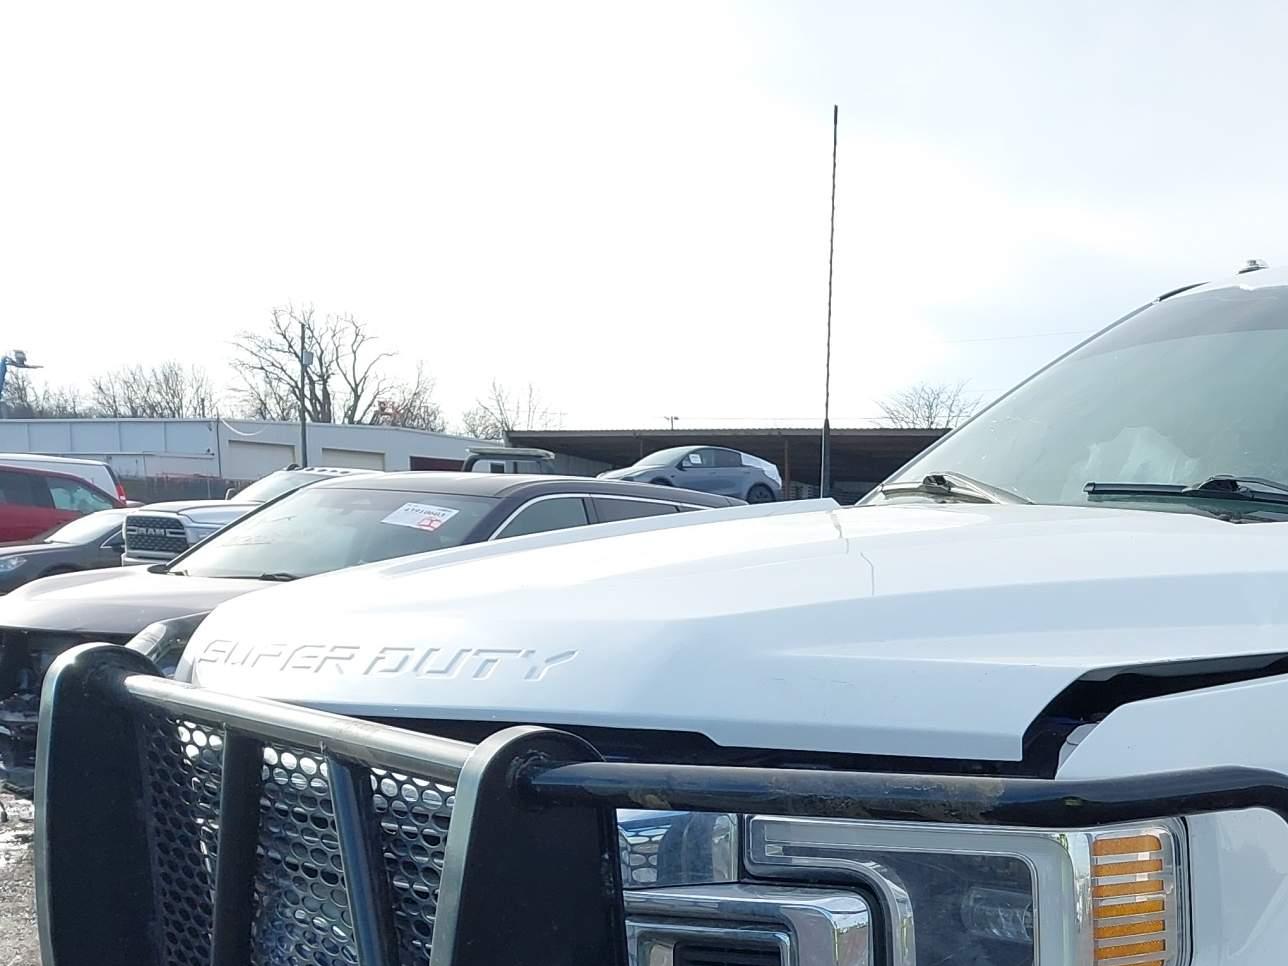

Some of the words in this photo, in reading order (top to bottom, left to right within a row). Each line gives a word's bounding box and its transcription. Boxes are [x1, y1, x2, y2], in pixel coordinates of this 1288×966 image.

[139, 527, 165, 537] RAM
[198, 638, 361, 675] SUPER
[362, 645, 583, 682] DUTY
